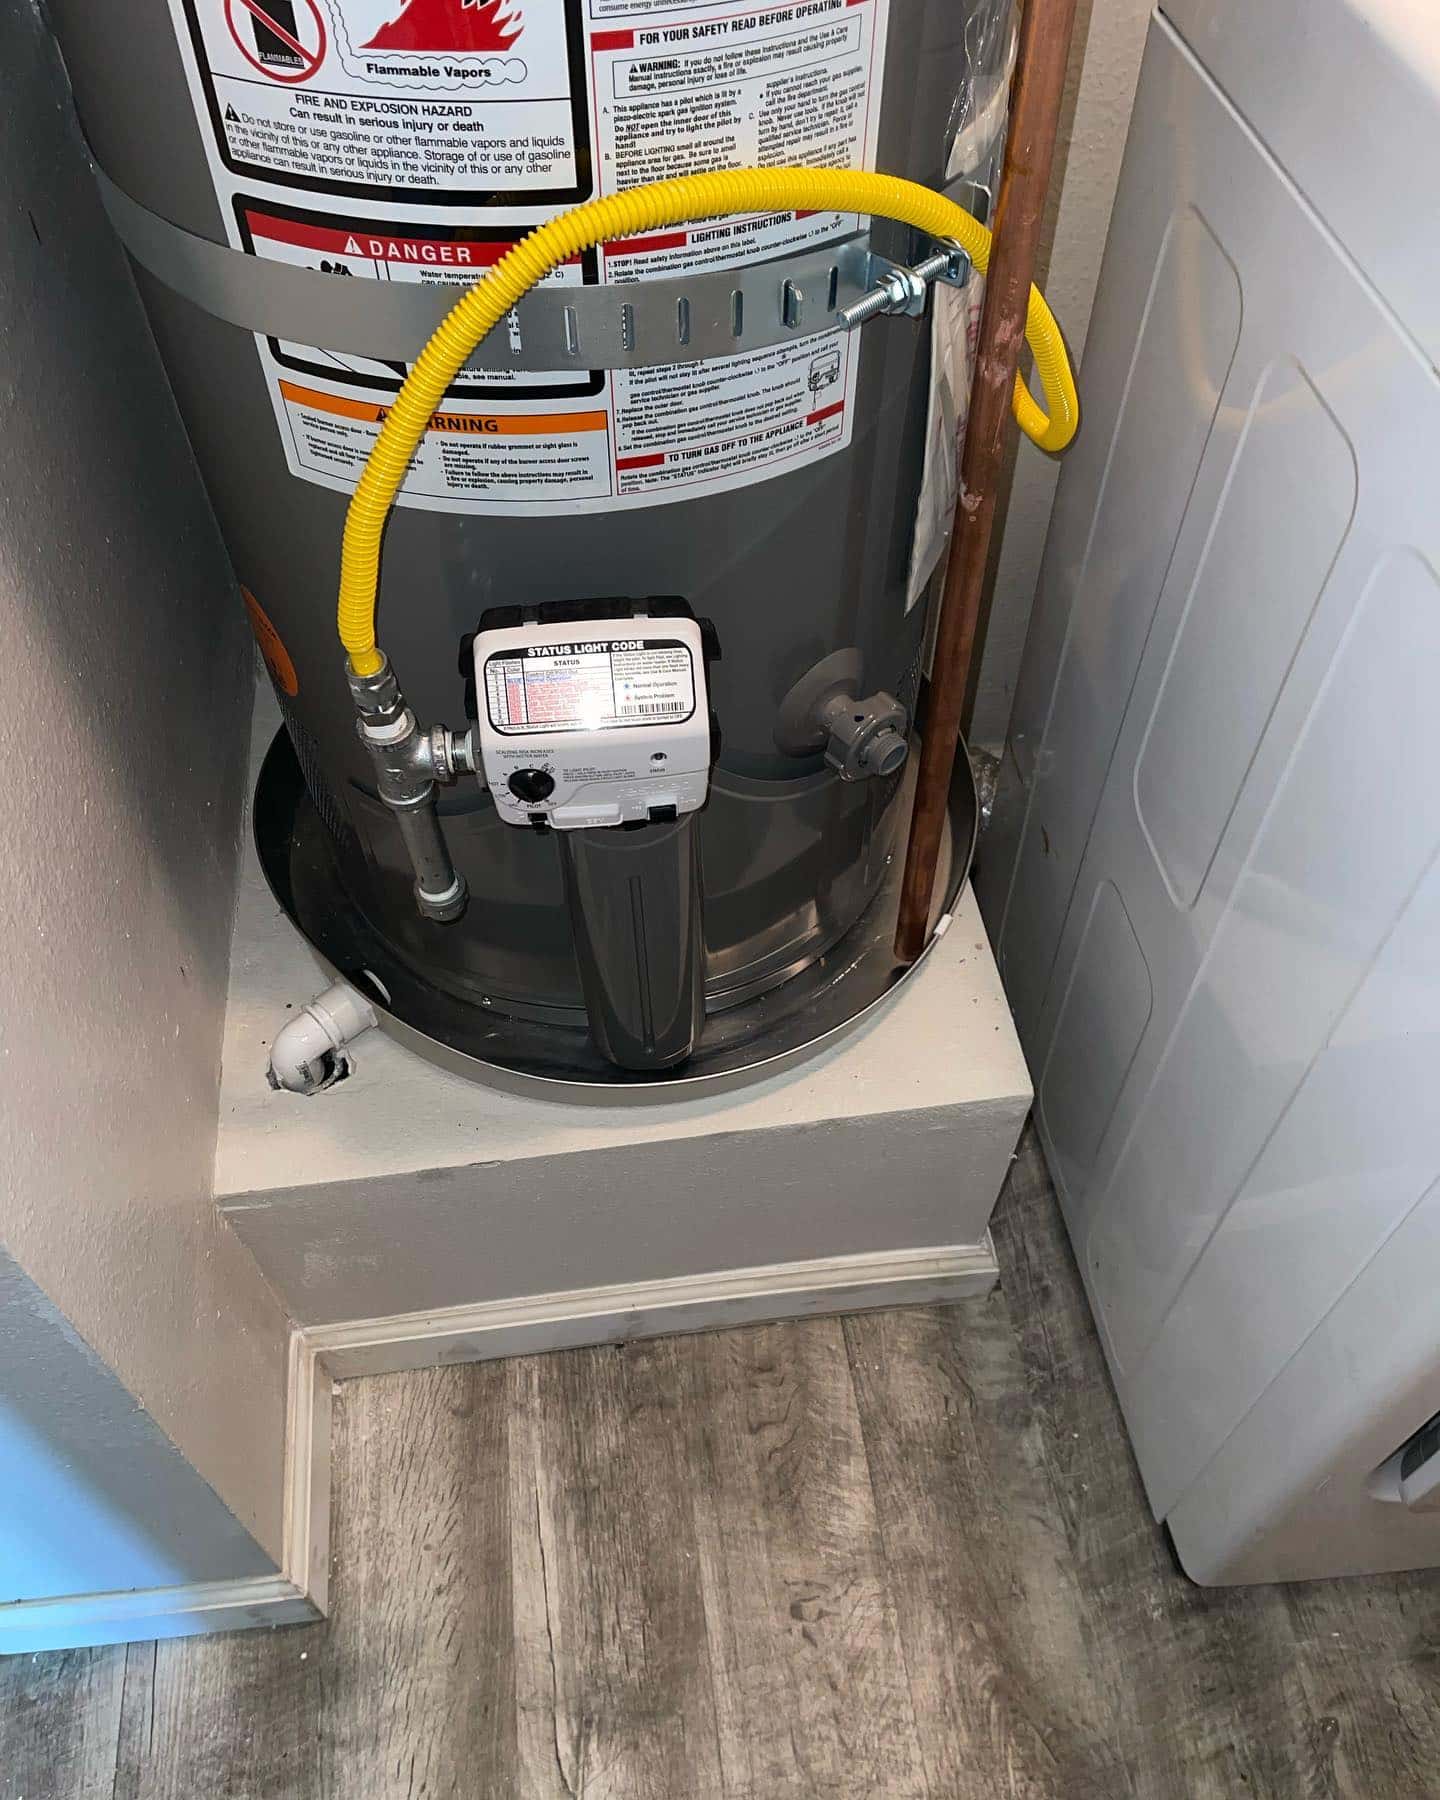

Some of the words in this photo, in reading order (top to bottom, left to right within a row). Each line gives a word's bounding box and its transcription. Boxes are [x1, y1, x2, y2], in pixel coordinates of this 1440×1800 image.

[640, 33, 659, 45] FOR
[663, 29, 689, 42] YOUR
[693, 22, 728, 39] SAFETY
[732, 19, 756, 32] READ
[760, 11, 792, 26] BEFORE
[796, 0, 842, 18] OPERATING
[629, 73, 652, 82] Manual
[654, 68, 691, 79] instructions
[694, 65, 716, 75] exactly,
[743, 54, 772, 66] explosion
[786, 47, 802, 56] result
[804, 43, 824, 52] causing
[826, 35, 848, 47] property
[639, 60, 681, 72] WARNING:
[684, 59, 689, 67] If
[690, 57, 702, 67] you
[704, 56, 711, 64] do
[713, 53, 723, 63] not
[725, 52, 742, 60] follow
[745, 48, 761, 56] these
[798, 36, 808, 45] and
[809, 34, 818, 43] the
[819, 30, 829, 39] Use
[836, 26, 848, 34] Care
[367, 64, 440, 76] Flammable
[444, 66, 491, 80] Vapors
[629, 81, 656, 91] damage,
[658, 79, 685, 89] personal
[687, 75, 704, 86] injury
[715, 71, 727, 79] loss
[295, 94, 321, 107] FIRE
[324, 98, 347, 109] AND
[352, 100, 418, 115] EXPLOSION
[422, 106, 472, 116] HAZARD
[242, 113, 254, 125] Do
[257, 117, 270, 127] not
[273, 120, 295, 132] store
[300, 126, 308, 134] or
[310, 127, 327, 137] use
[330, 129, 370, 142] gasoline
[374, 135, 383, 144] or
[387, 135, 411, 145] other
[415, 137, 468, 148] flammable
[471, 138, 506, 149] vapors
[510, 137, 528, 147] and
[532, 136, 565, 148] liquids
[290, 107, 310, 120] Can
[314, 110, 342, 123] result
[346, 114, 355, 125] in
[359, 117, 399, 129] serious
[402, 119, 433, 132] injury
[437, 122, 448, 131] or
[453, 121, 484, 132] death
[626, 122, 640, 132] NOT
[641, 123, 658, 131] open
[660, 119, 672, 127] the
[674, 116, 692, 125] inner
[235, 125, 248, 135] the
[250, 129, 278, 144] vicinity
[282, 134, 290, 143] of
[292, 137, 309, 148] this
[311, 140, 320, 148] or
[323, 142, 340, 154] any
[343, 144, 367, 154] other
[371, 146, 421, 159] appliance.
[424, 151, 464, 163] Storage
[468, 152, 478, 161] of
[480, 153, 490, 161] or
[494, 153, 512, 161] use
[516, 151, 525, 160] of
[528, 150, 571, 162] gasoline
[239, 137, 260, 148] other
[263, 142, 308, 159] flammable
[311, 152, 342, 164] vapors
[345, 157, 354, 165] or
[358, 157, 387, 170] liquids
[391, 160, 399, 169] in
[403, 160, 418, 171] the
[421, 162, 455, 175] vicinity
[458, 164, 468, 173] of
[471, 163, 489, 174] this
[491, 165, 501, 174] or
[505, 166, 522, 175] any
[526, 163, 552, 173] other
[232, 148, 271, 163] appliance
[273, 157, 290, 167] can
[292, 160, 317, 173] result
[319, 164, 327, 174] in
[330, 165, 364, 179] serious
[367, 172, 392, 184] injury
[395, 175, 406, 183] or
[408, 174, 439, 185] death.
[691, 228, 731, 244] LIGHTING
[734, 213, 792, 236] INSTRUCTIONS
[369, 240, 471, 263] DANGER
[634, 257, 648, 265] Read
[650, 253, 668, 264] safety
[669, 249, 702, 260] information
[704, 246, 721, 254] above
[742, 239, 756, 247] label.
[420, 270, 442, 278] Water
[460, 442, 482, 450] operate
[483, 442, 487, 450] if
[488, 442, 507, 450] rubber
[508, 442, 534, 450] grommet
[543, 442, 557, 450] sight
[558, 442, 572, 450] glass
[669, 454, 679, 462] TO
[682, 450, 701, 460] TURN
[704, 445, 718, 455] GAS
[721, 442, 736, 452] OFF
[738, 439, 747, 447] TO
[750, 435, 763, 444] THE
[766, 421, 803, 440] APPLIANCE
[528, 646, 571, 656] STATUS
[575, 642, 609, 653] LIGHT
[611, 641, 644, 650] CODE
